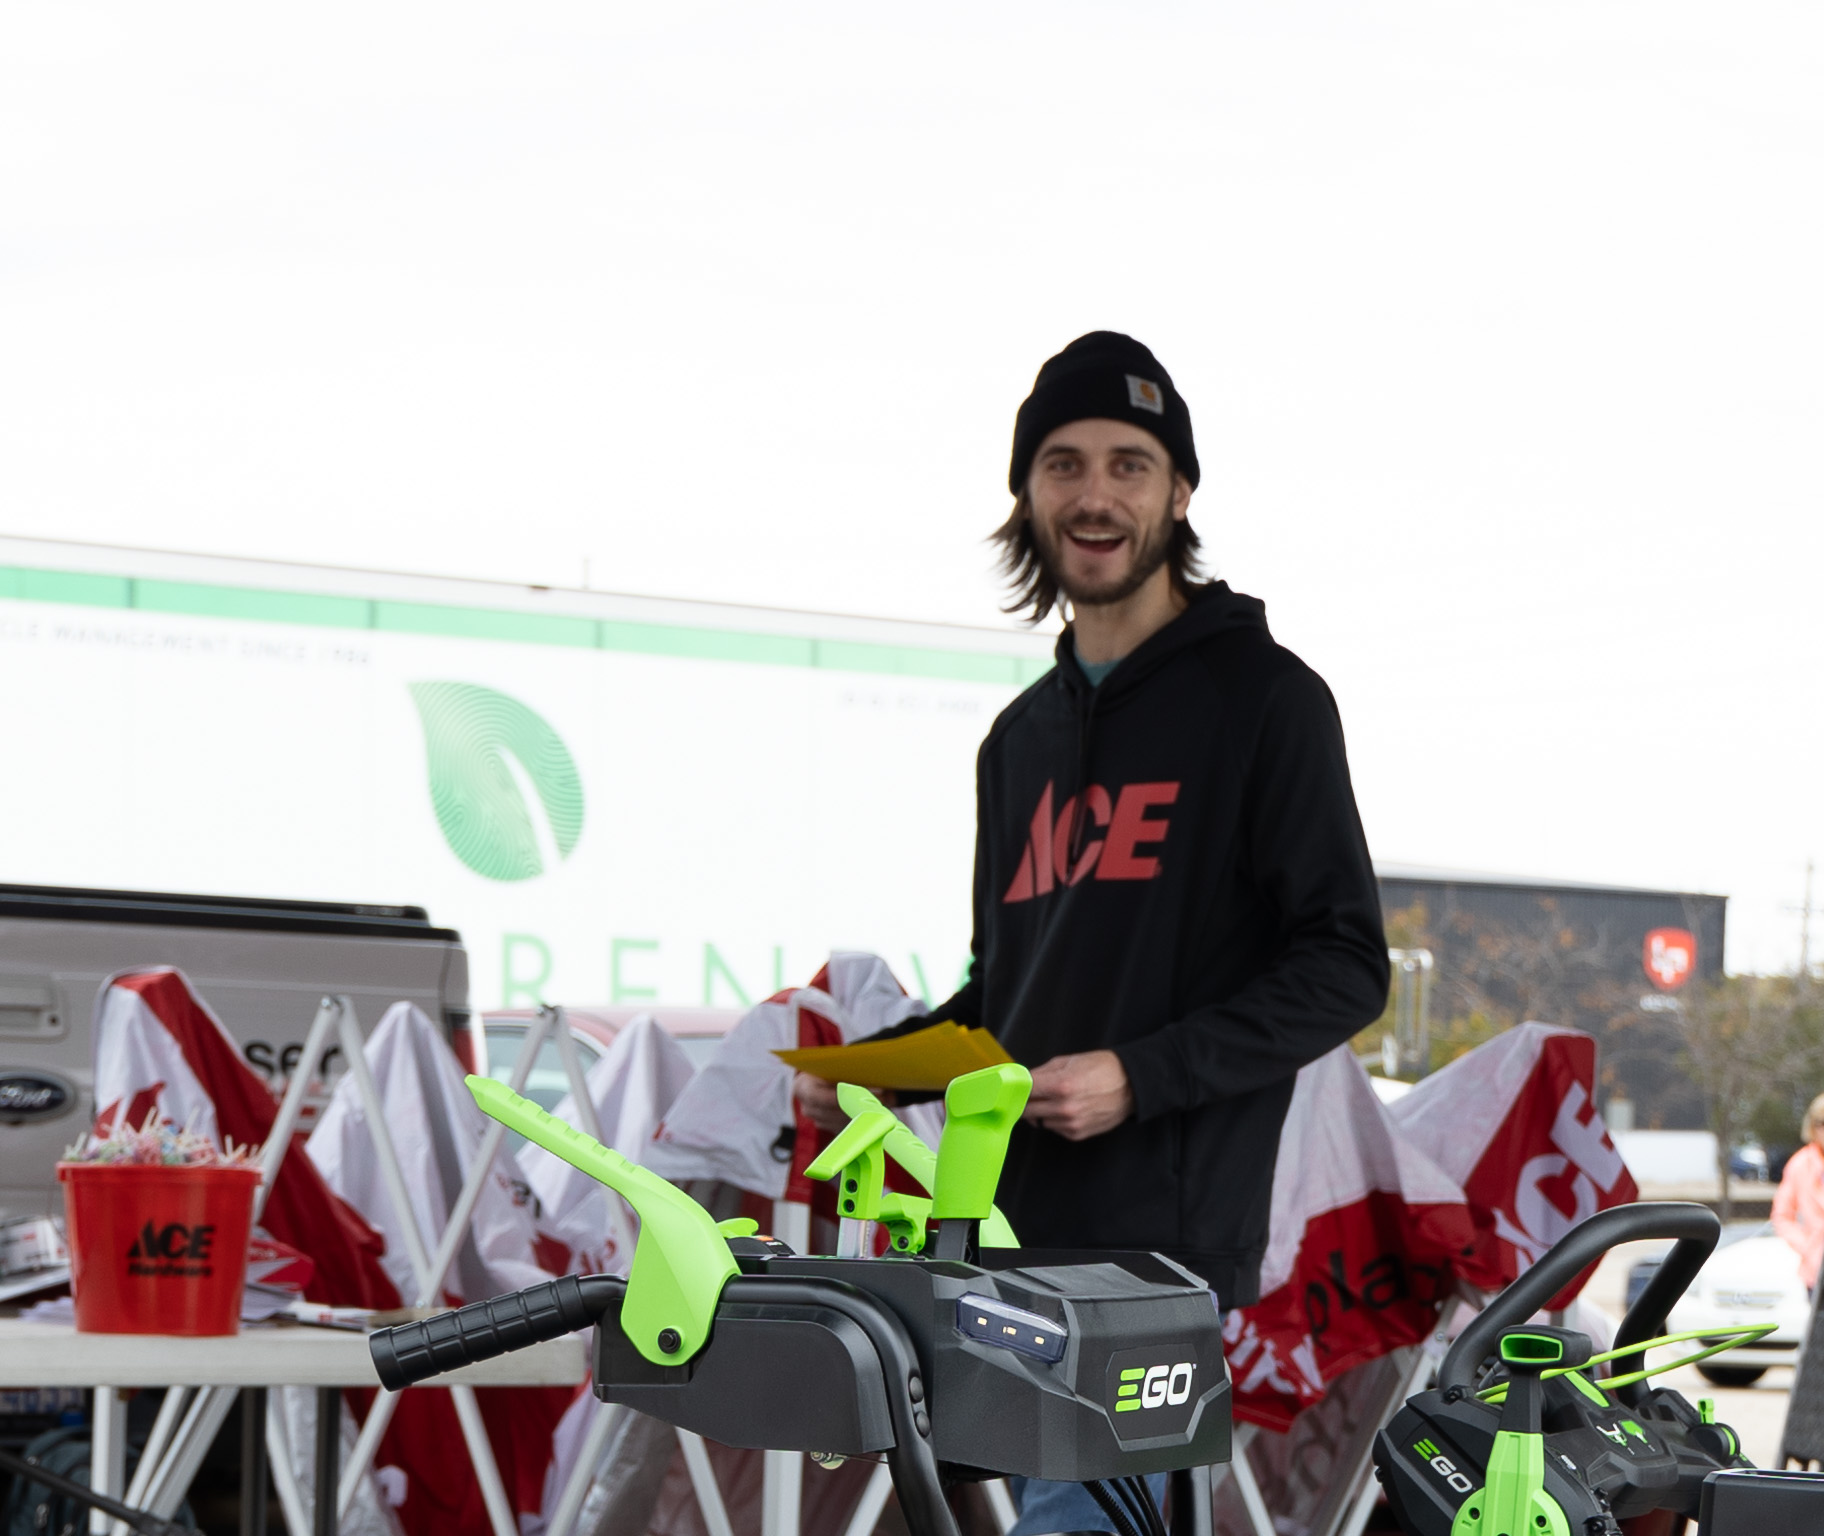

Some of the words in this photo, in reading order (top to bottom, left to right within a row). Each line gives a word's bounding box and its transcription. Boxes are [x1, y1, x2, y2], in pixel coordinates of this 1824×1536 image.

[1002, 778, 1181, 904] ACE
[128, 1219, 216, 1259] ACE
[128, 1260, 213, 1278] Hardware
[1115, 1362, 1193, 1413] EGO
[1412, 1437, 1472, 1495] EGO
